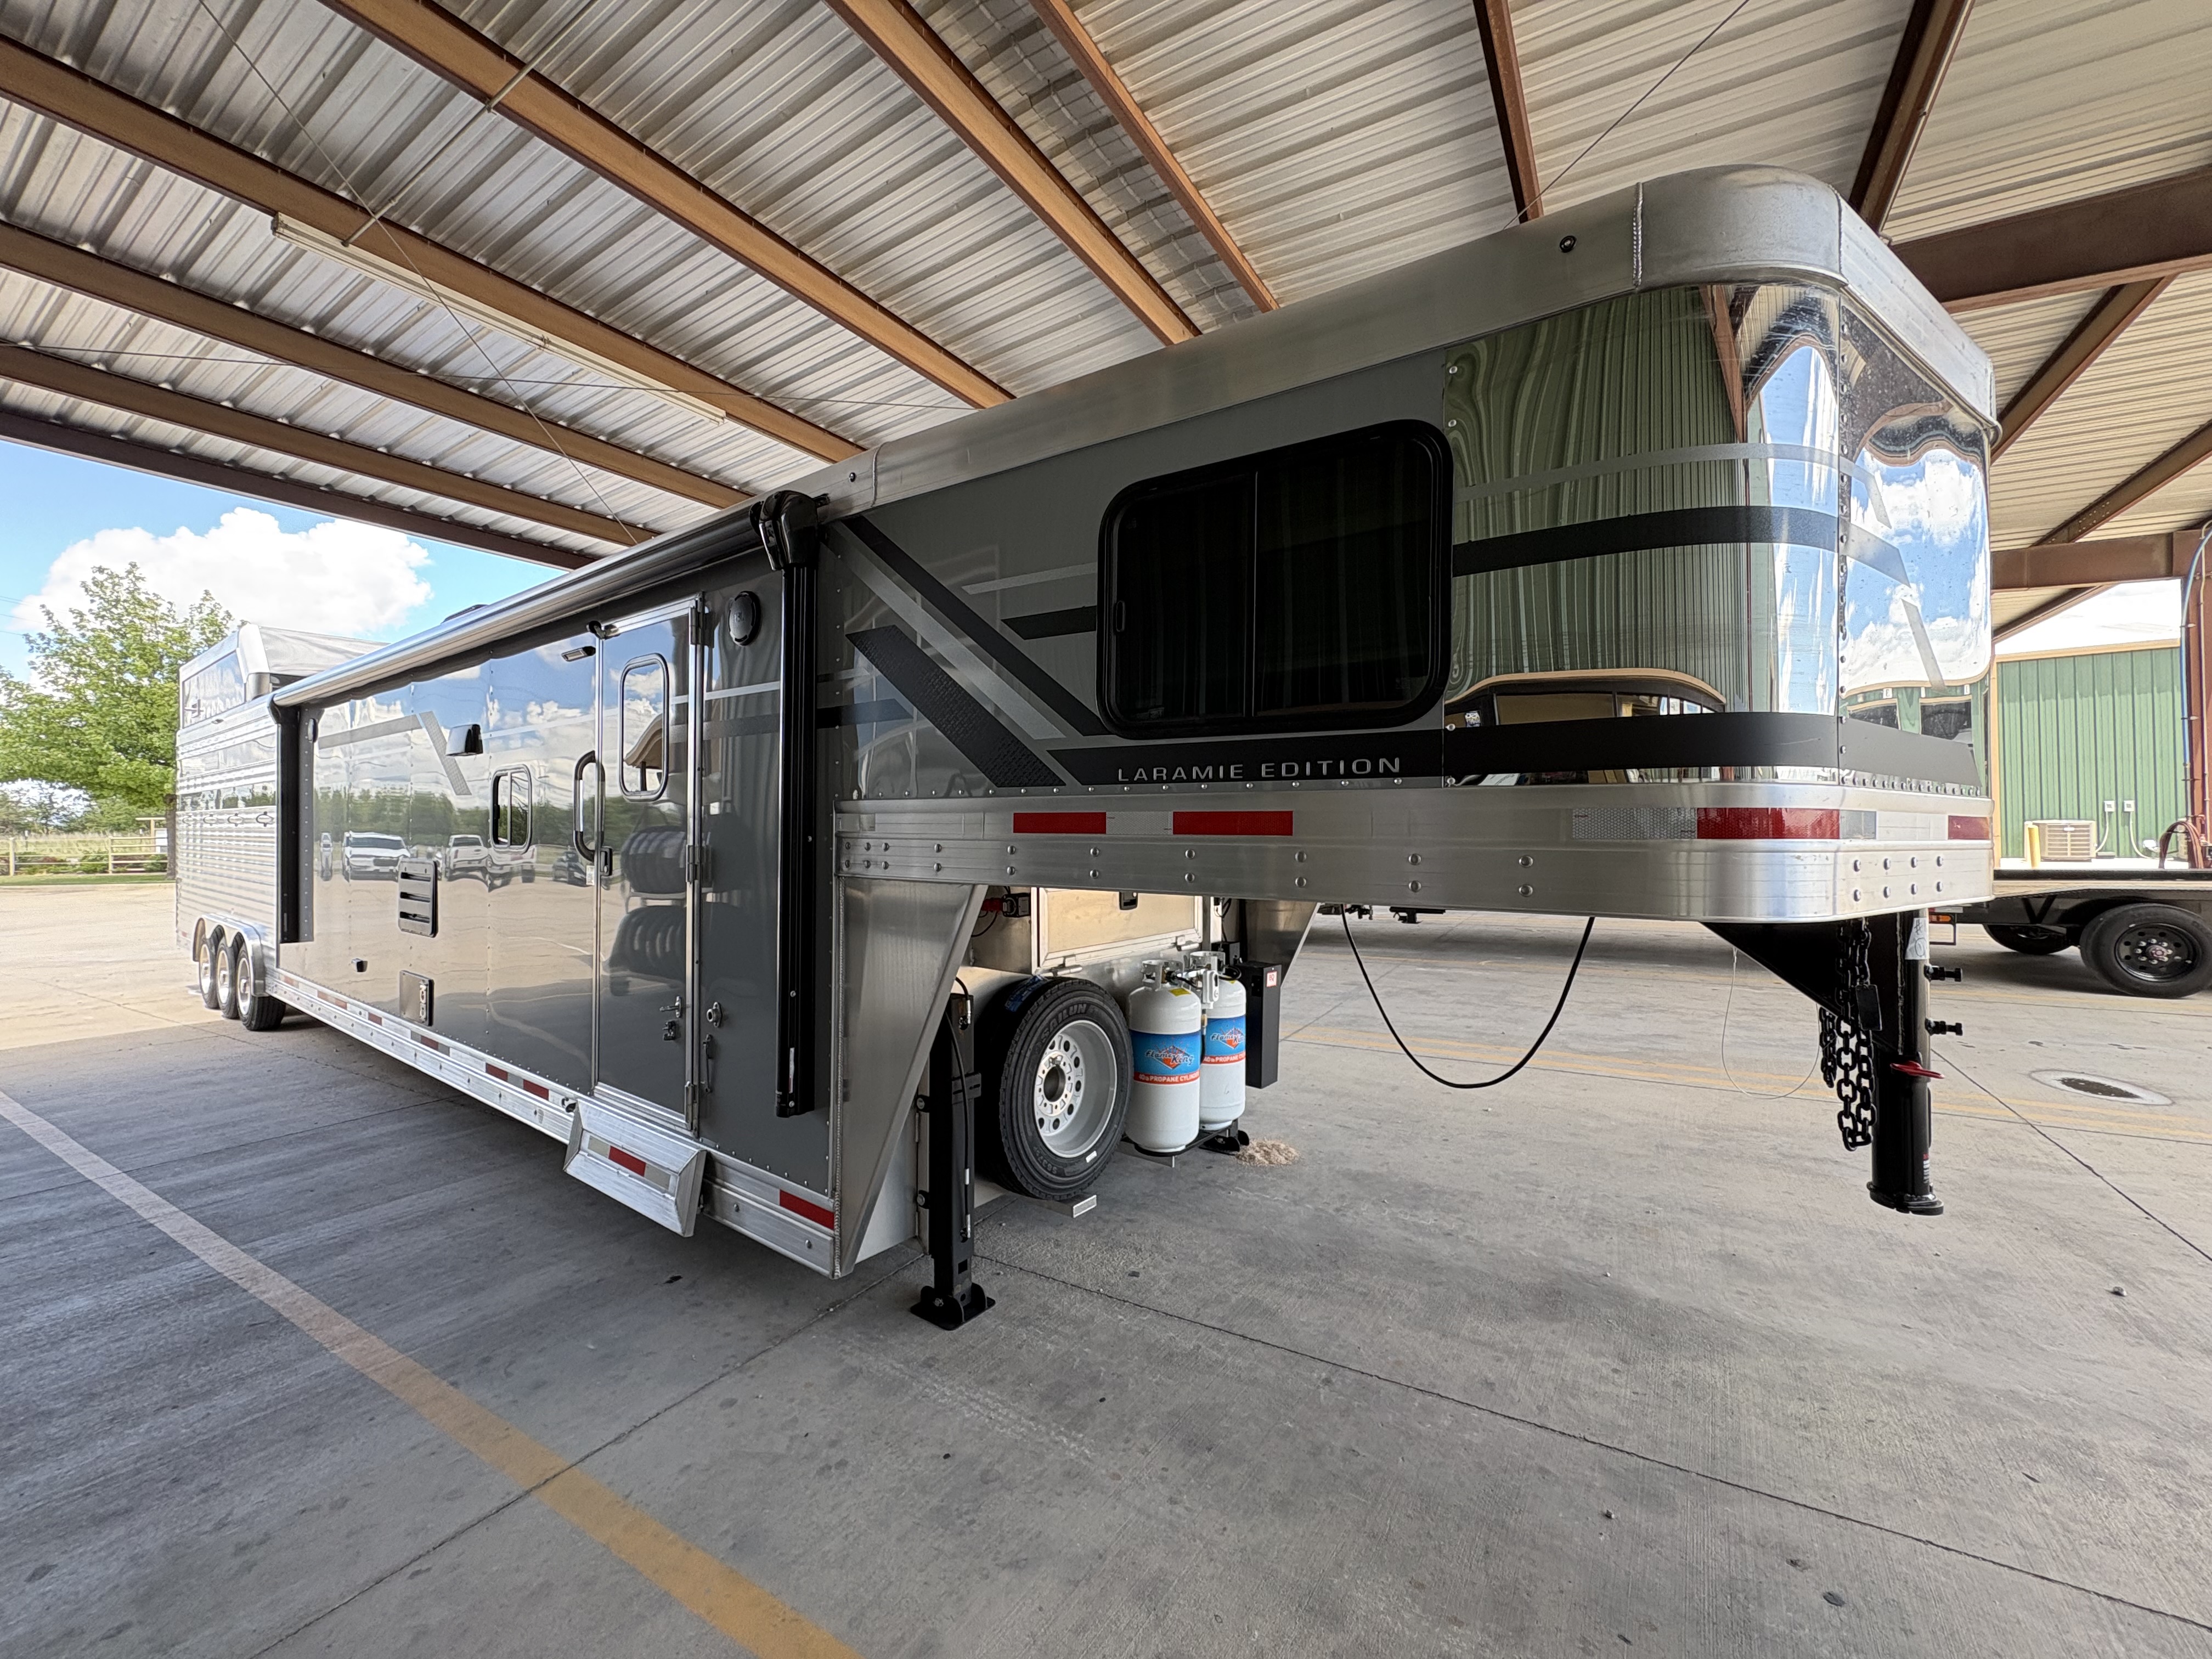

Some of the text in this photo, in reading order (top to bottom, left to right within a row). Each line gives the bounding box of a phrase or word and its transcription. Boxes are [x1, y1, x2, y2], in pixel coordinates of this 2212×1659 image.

[1118, 757, 1400, 782] LARAMIE EDITION
[1041, 1003, 1087, 1042] SAILUN
[1146, 1049, 1193, 1066] Flame King
[1215, 1054, 1239, 1063] PROPANE
